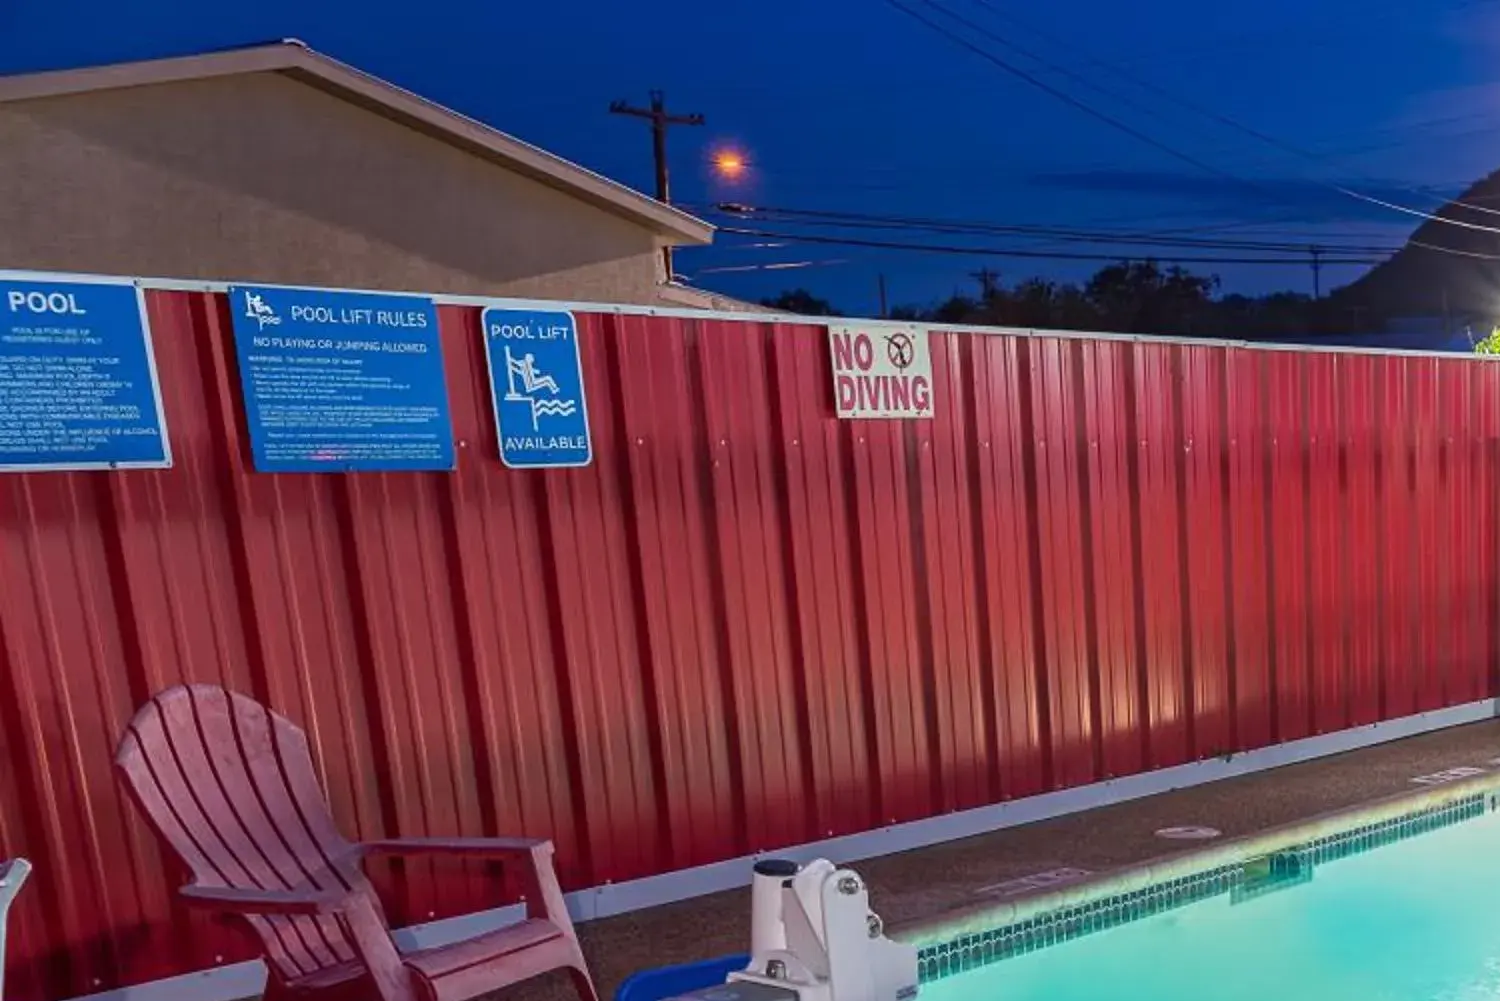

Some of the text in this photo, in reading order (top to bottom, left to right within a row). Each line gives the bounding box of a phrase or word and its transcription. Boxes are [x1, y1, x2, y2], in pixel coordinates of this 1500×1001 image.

[8, 291, 87, 315] POOL
[291, 306, 428, 328] POOL LIFT RULES
[491, 324, 568, 340] POOL LIFT
[254, 336, 270, 346] NO
[271, 337, 316, 349] PLAYING
[334, 339, 381, 351] JUMPING
[382, 343, 427, 353] ALLOWED
[832, 333, 873, 370] NO
[838, 375, 930, 411] DIVING
[505, 436, 587, 451] AVAILABLE
